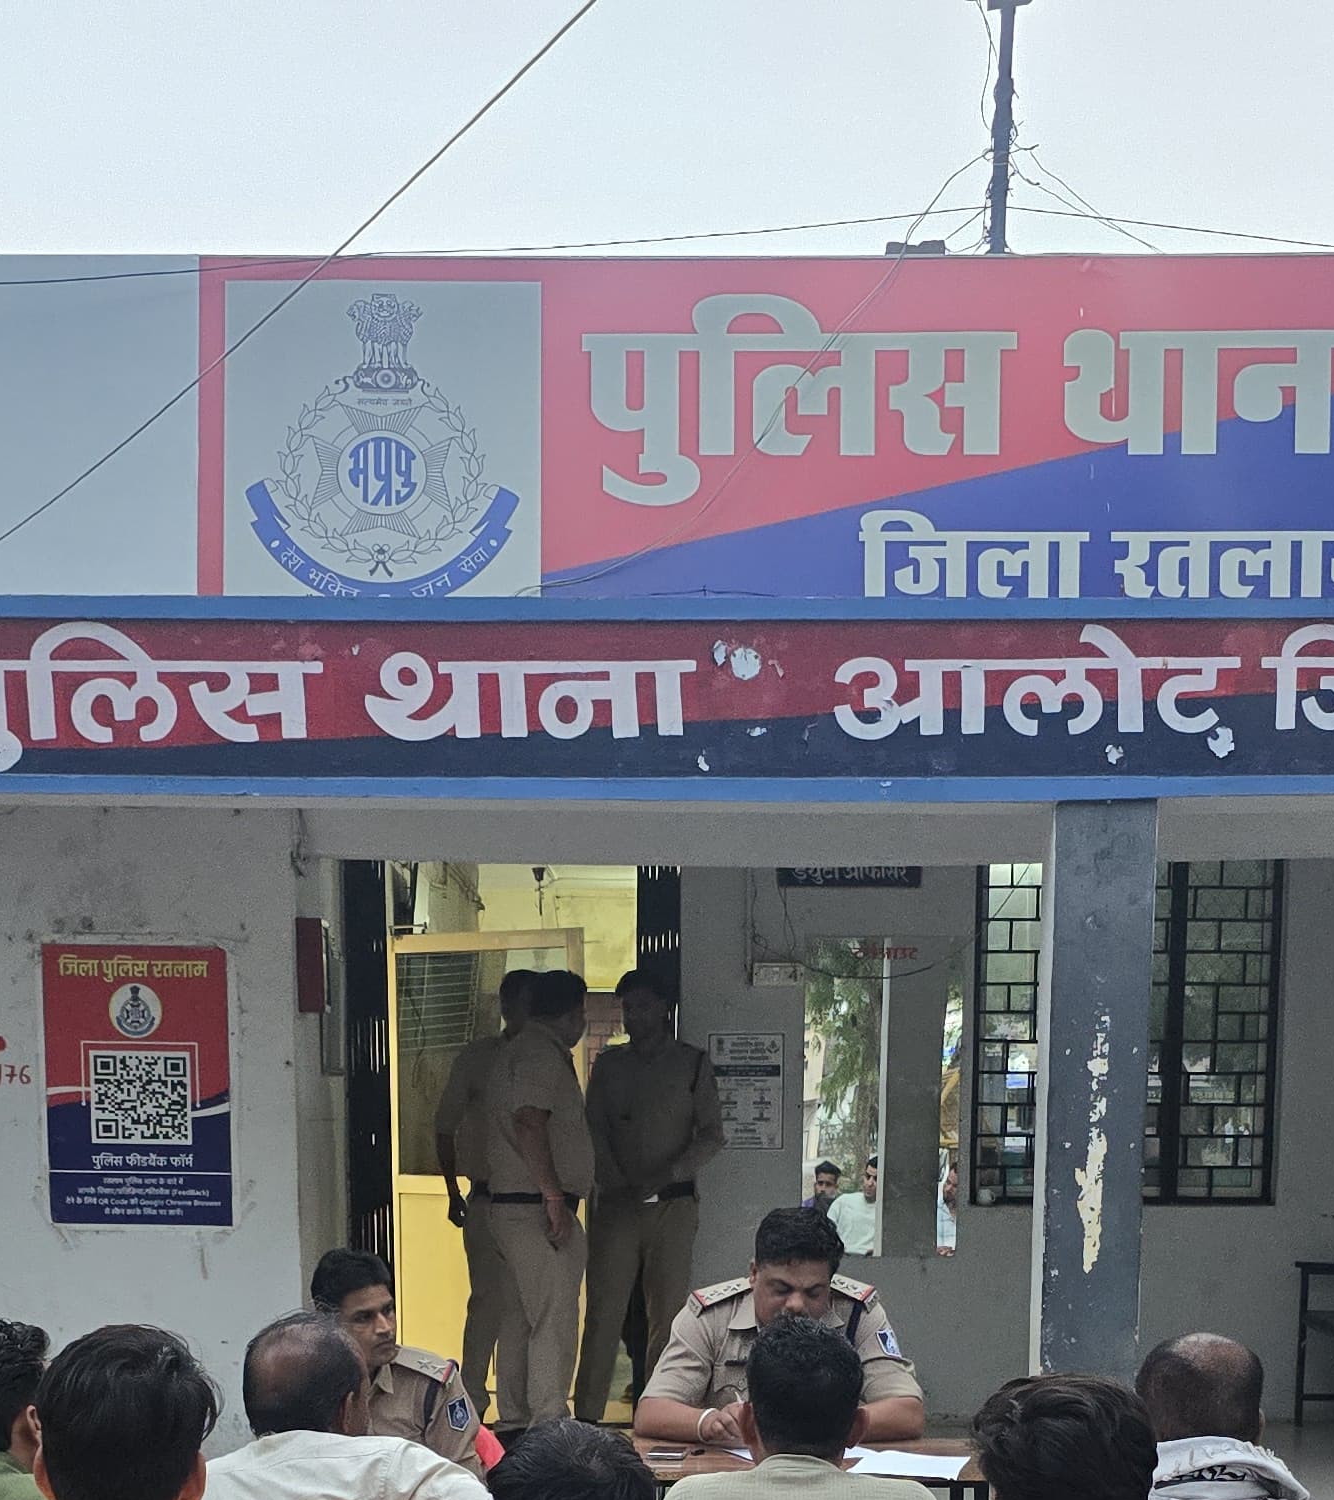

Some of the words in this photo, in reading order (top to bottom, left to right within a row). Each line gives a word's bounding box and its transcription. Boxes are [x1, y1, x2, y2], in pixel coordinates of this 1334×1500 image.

[582, 294, 1017, 506] पुलिस
[280, 546, 306, 573] देश
[457, 546, 490, 573] सेवा
[859, 510, 1089, 598] जिला
[365, 651, 697, 742] थाना
[58, 954, 99, 977] जिला
[101, 954, 149, 983] पुलिस
[151, 960, 209, 978] रतलाम
[91, 1152, 123, 1170] पुलिस
